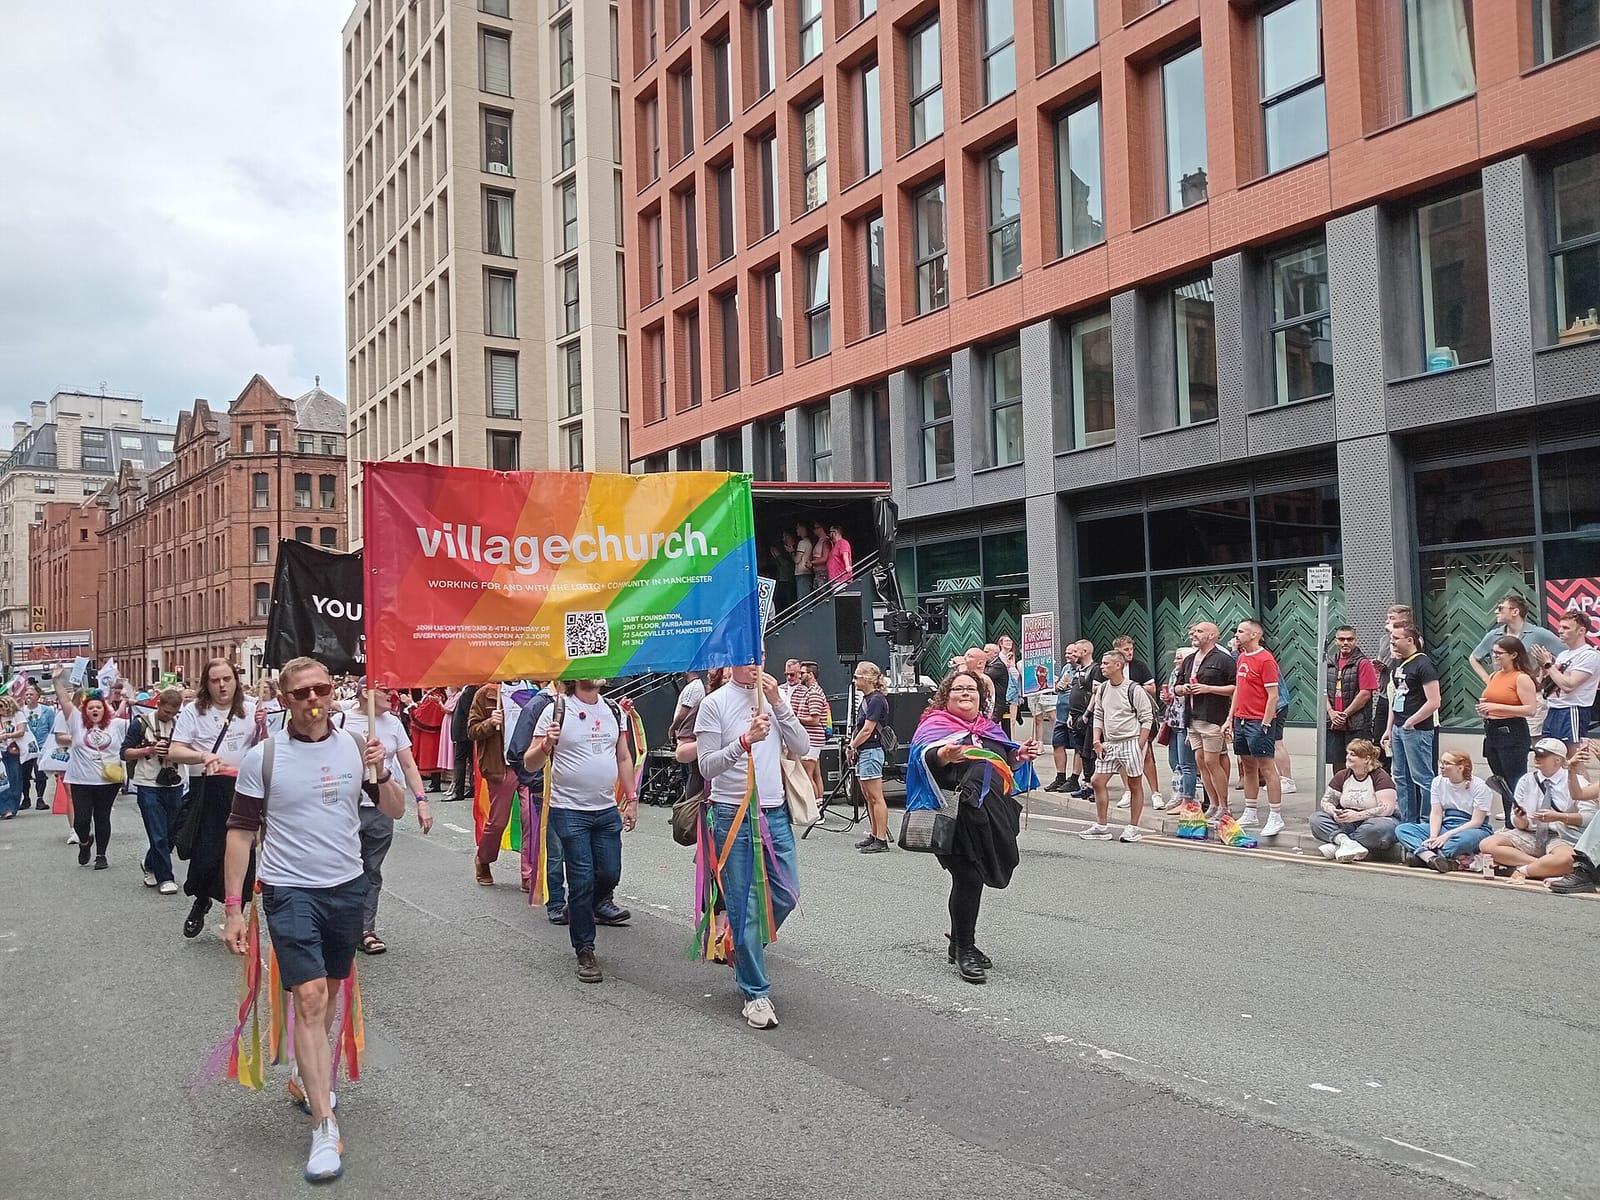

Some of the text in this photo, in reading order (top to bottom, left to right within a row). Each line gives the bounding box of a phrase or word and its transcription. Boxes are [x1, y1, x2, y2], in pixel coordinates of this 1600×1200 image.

[416, 522, 718, 575] villagechurch.
[428, 580, 478, 590] WORKING
[481, 581, 501, 591] FOR
[503, 582, 522, 591] AND
[525, 583, 549, 592] WITH
[552, 583, 570, 592] THE
[607, 578, 650, 590] COMMUNITY
[652, 576, 661, 586] IN
[663, 575, 713, 585] MANCHESTER
[312, 594, 362, 621] YOU
[622, 613, 682, 623] LGBT FOUNDATION,
[637, 622, 661, 630] FLOOR,
[661, 619, 693, 628] FAIRBAIRN
[493, 632, 513, 640] OPEN
[515, 632, 523, 640] AT
[631, 629, 665, 638] SACKVILLE
[675, 626, 713, 635] MANCHESTER
[488, 640, 521, 648] WORSHIP
[622, 639, 630, 647] M1
